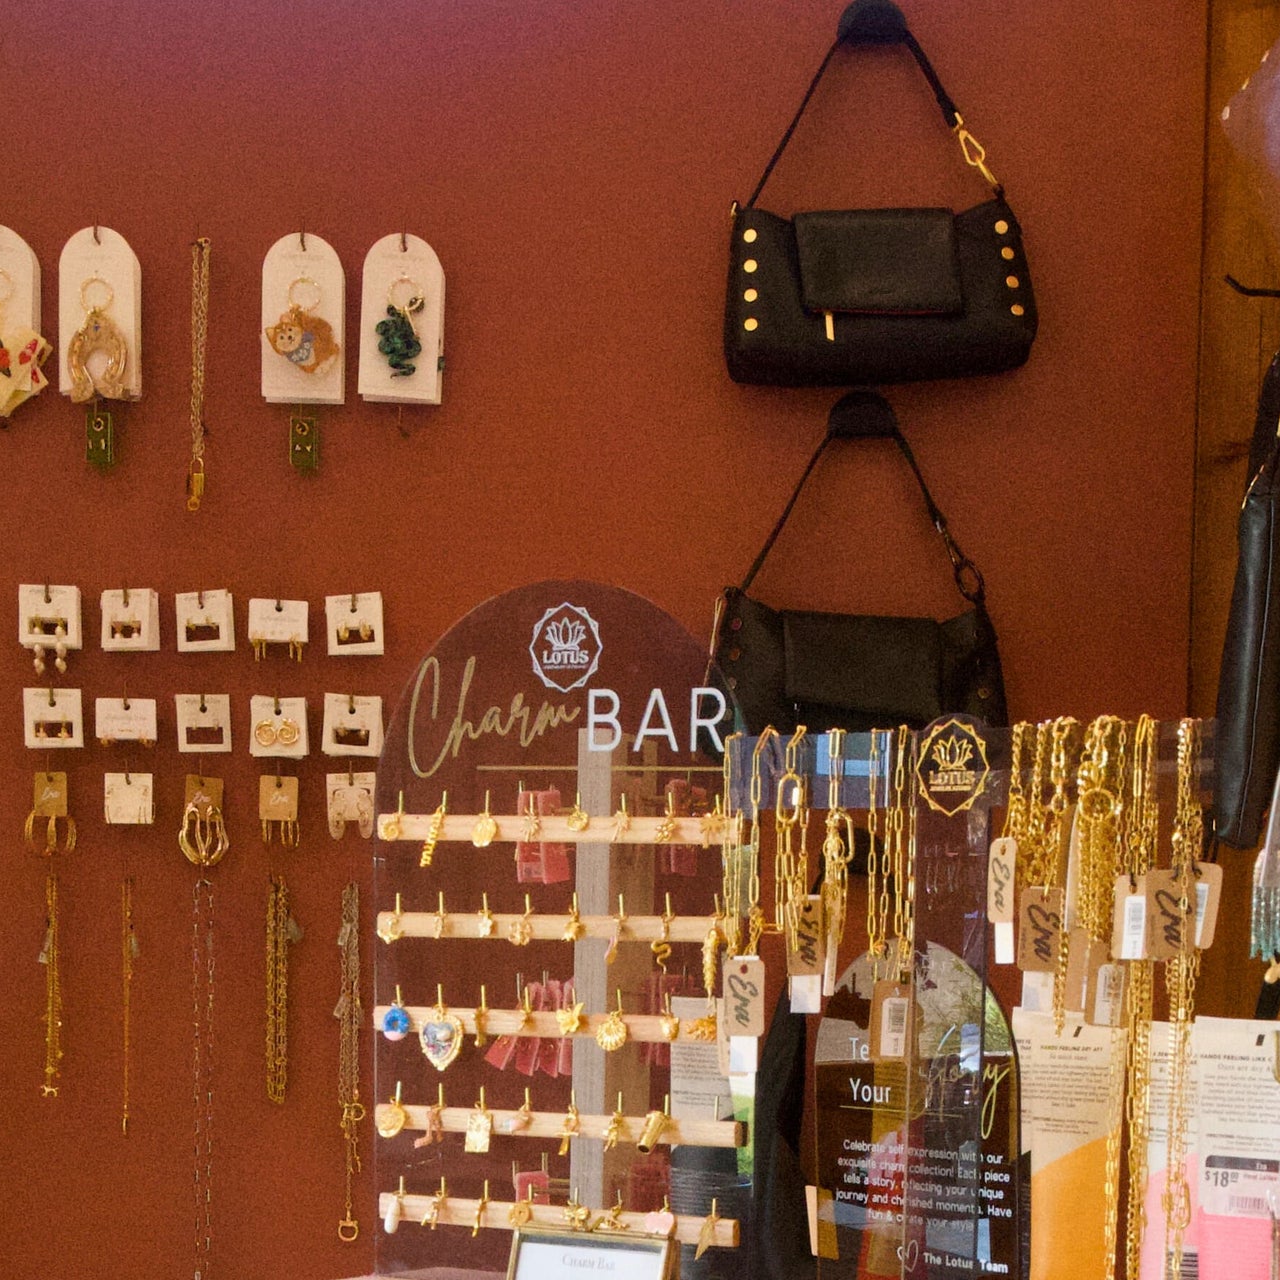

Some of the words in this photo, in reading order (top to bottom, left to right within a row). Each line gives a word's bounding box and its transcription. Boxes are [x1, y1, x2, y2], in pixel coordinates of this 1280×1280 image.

[542, 650, 589, 664] LOTUS
[408, 656, 580, 778] Charm
[586, 687, 727, 753] BAR
[929, 770, 976, 784] LOTUS
[849, 1037, 869, 1060] Te
[849, 1078, 891, 1103] Your
[843, 1139, 887, 1154] Celebrate
[907, 1147, 958, 1163] expression
[986, 1154, 1003, 1164] our
[837, 1156, 877, 1170] exquisite
[879, 1160, 905, 1172] charm
[984, 1170, 1010, 1184] piece
[843, 1173, 860, 1184] tells
[945, 1186, 967, 1197] your
[836, 1188, 869, 1204] journey
[872, 1192, 888, 1203] and
[891, 1194, 933, 1209] chished
[987, 1205, 1012, 1218] Have
[896, 1212, 923, 1226] cate
[923, 1252, 942, 1264] The
[945, 1256, 973, 1269] Lotus
[979, 1258, 1009, 1274] Team
